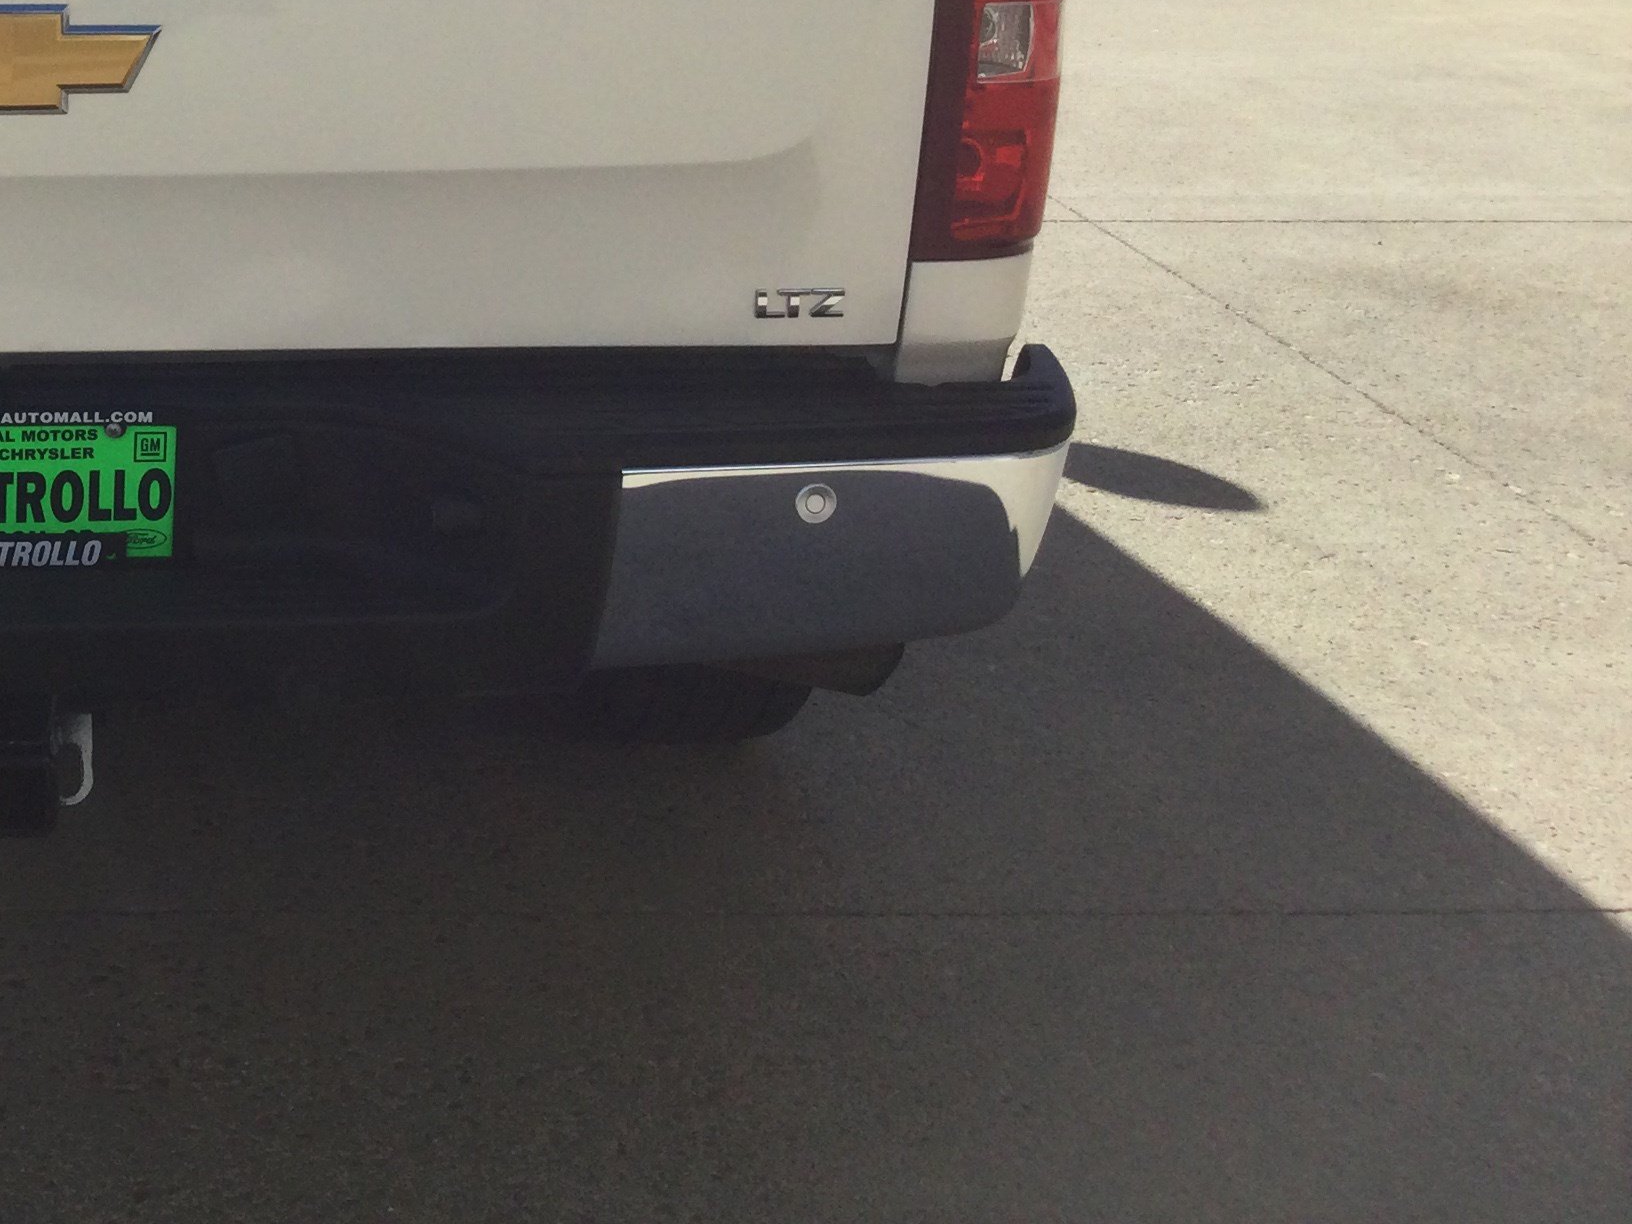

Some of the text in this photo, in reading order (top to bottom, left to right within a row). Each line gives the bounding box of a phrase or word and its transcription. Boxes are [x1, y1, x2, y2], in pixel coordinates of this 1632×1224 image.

[755, 288, 846, 318] LTZ
[21, 428, 99, 443] MOTORS
[139, 437, 161, 453] GM
